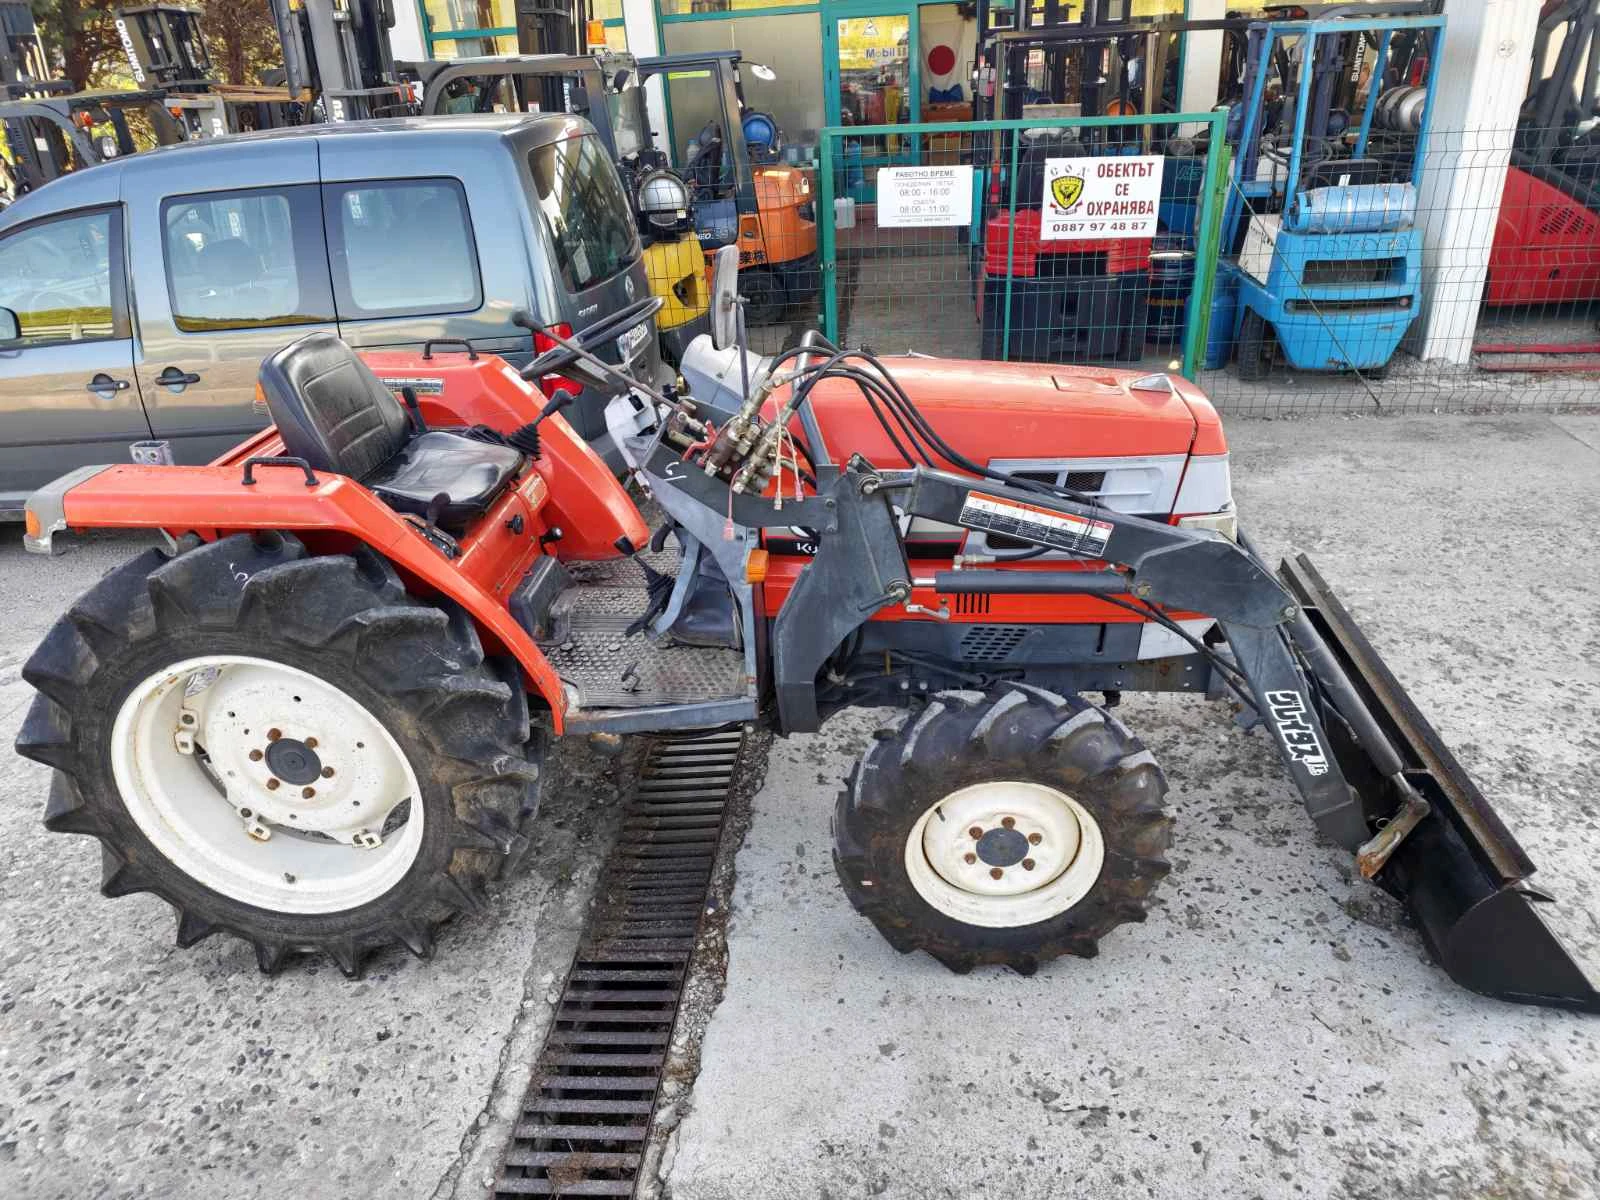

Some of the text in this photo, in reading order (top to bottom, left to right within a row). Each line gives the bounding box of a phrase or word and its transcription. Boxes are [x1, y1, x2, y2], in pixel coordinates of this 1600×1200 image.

[865, 47, 896, 59] Mobil
[1097, 162, 1155, 178] ОБЕКТЪТ
[1115, 183, 1130, 196] СЕ
[1087, 200, 1154, 216] ОХРАНЯВА
[1053, 221, 1147, 233] 0887 97 48 87
